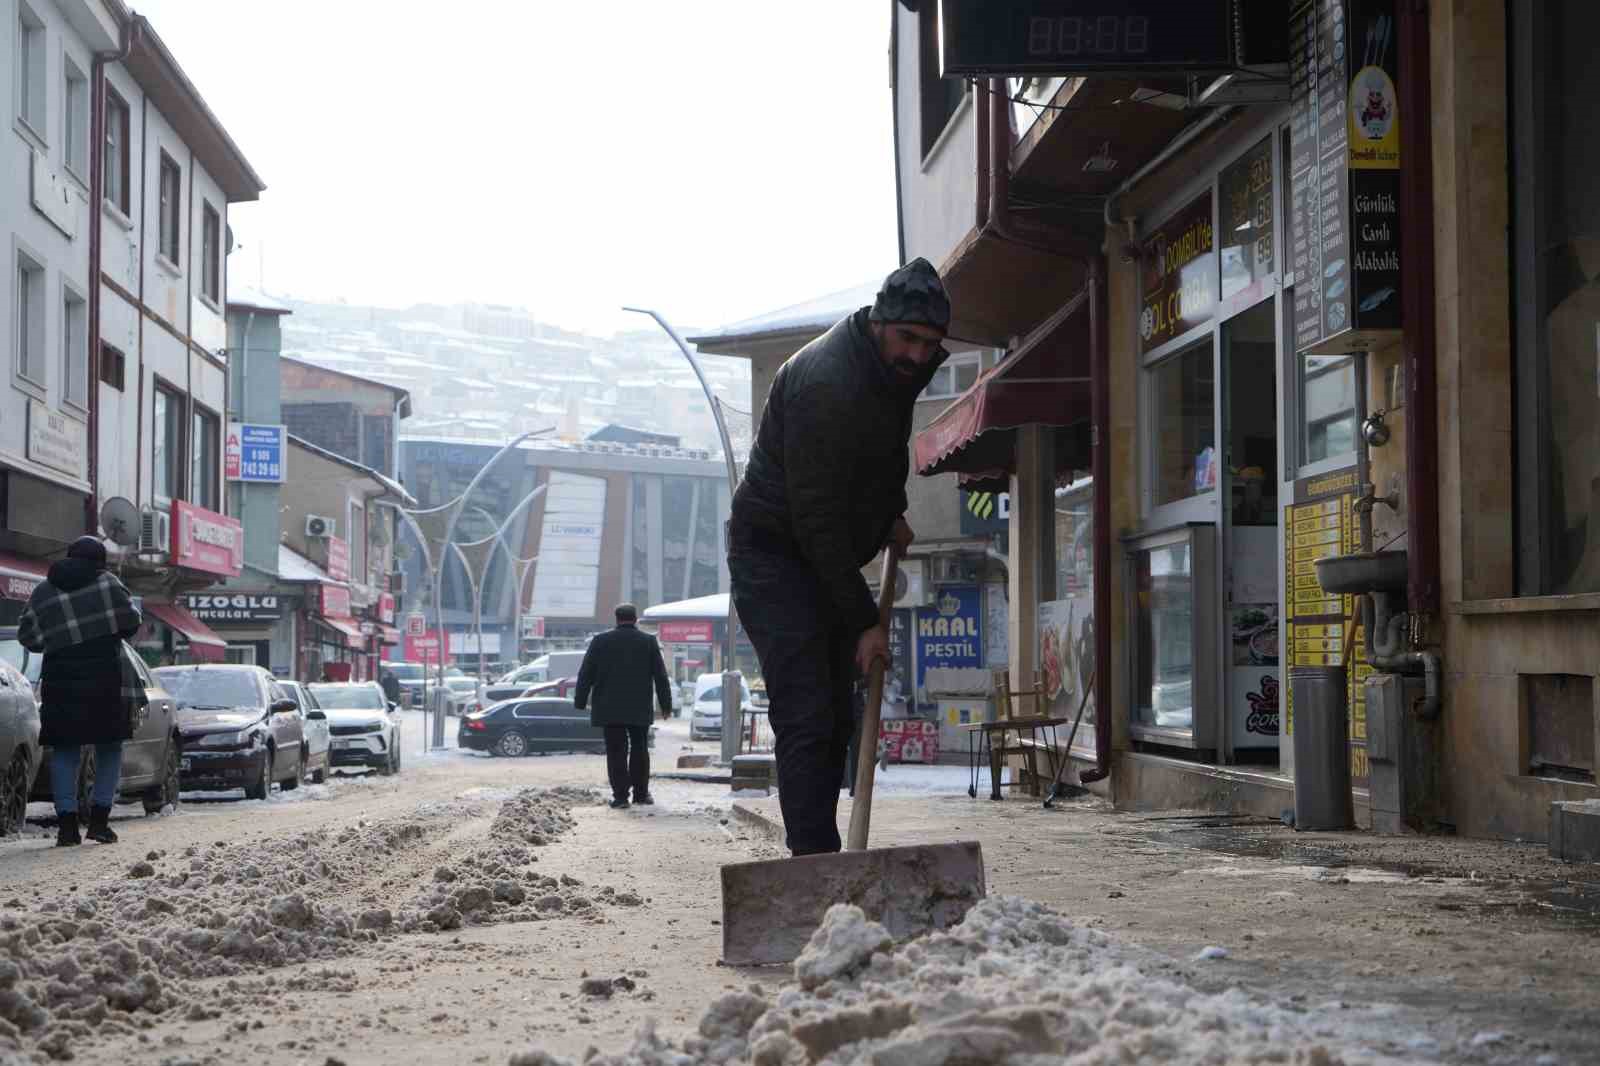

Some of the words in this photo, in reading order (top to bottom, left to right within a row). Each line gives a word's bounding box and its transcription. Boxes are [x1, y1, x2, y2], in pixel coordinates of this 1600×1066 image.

[1355, 193, 1395, 213] Günlük
[1362, 222, 1390, 241] Canlı
[1354, 251, 1399, 271] Alabalık
[919, 617, 977, 637] KAAL
[925, 639, 976, 657] PESTİL
